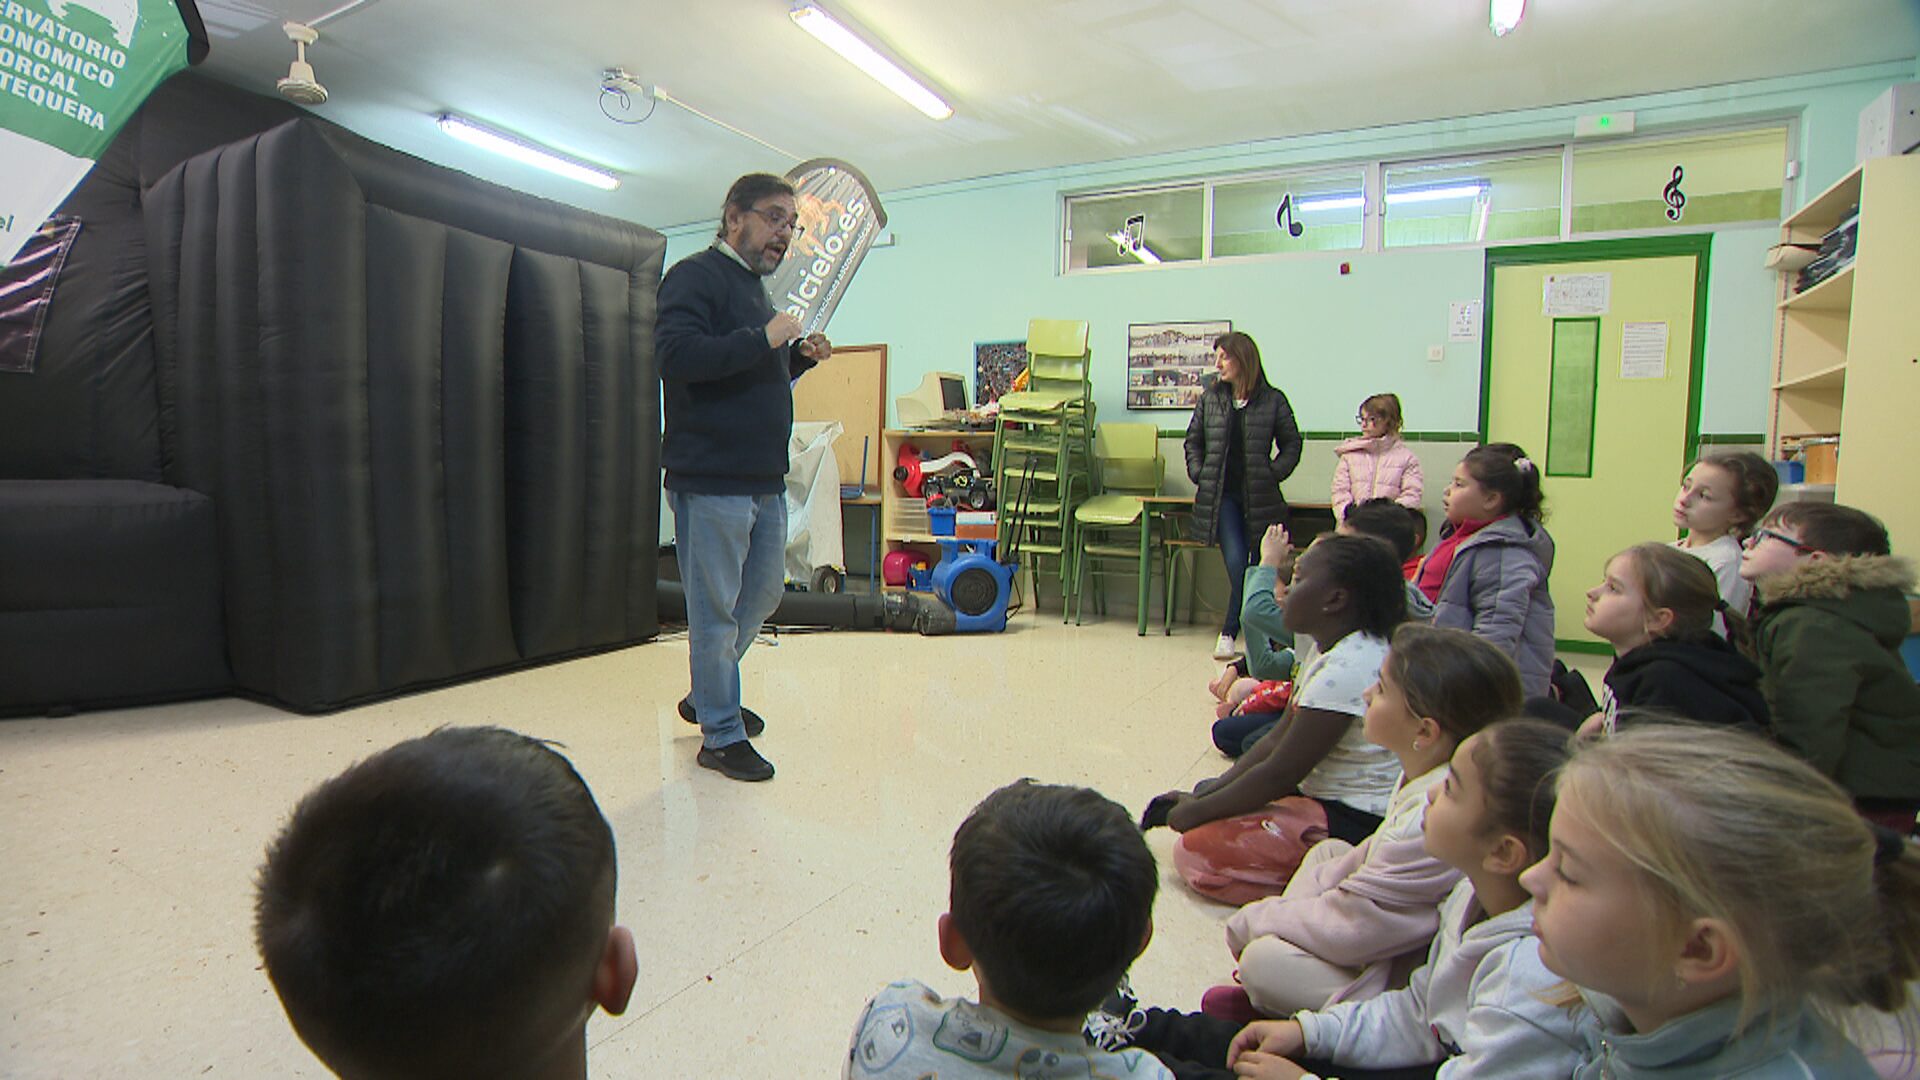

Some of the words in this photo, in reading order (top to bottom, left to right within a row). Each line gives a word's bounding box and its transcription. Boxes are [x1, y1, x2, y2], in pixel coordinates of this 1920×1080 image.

[0, 23, 115, 88] ONÓMICO
[0, 47, 79, 96] ORCAL
[0, 71, 105, 131] TEQUERA
